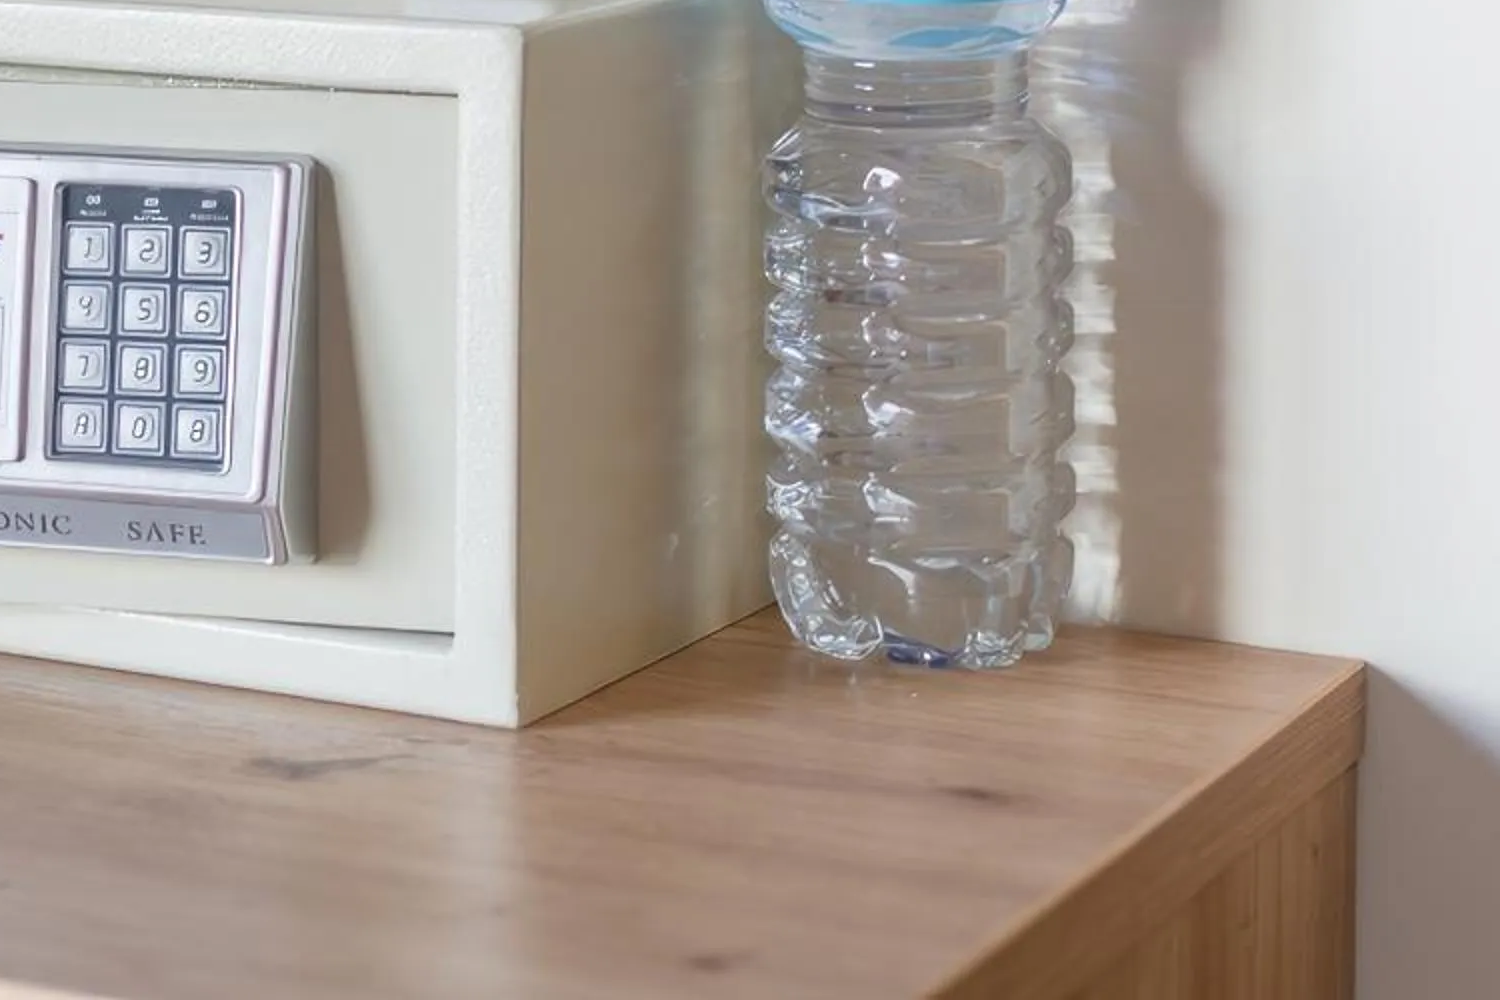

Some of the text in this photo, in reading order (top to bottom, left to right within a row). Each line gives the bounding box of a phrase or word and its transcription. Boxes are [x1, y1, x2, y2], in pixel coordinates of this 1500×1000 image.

[139, 239, 155, 263] 2
[197, 241, 213, 265] 3
[78, 295, 211, 323] 4 5 6
[77, 354, 209, 383] 7 8 9
[126, 520, 207, 546] SAFE
